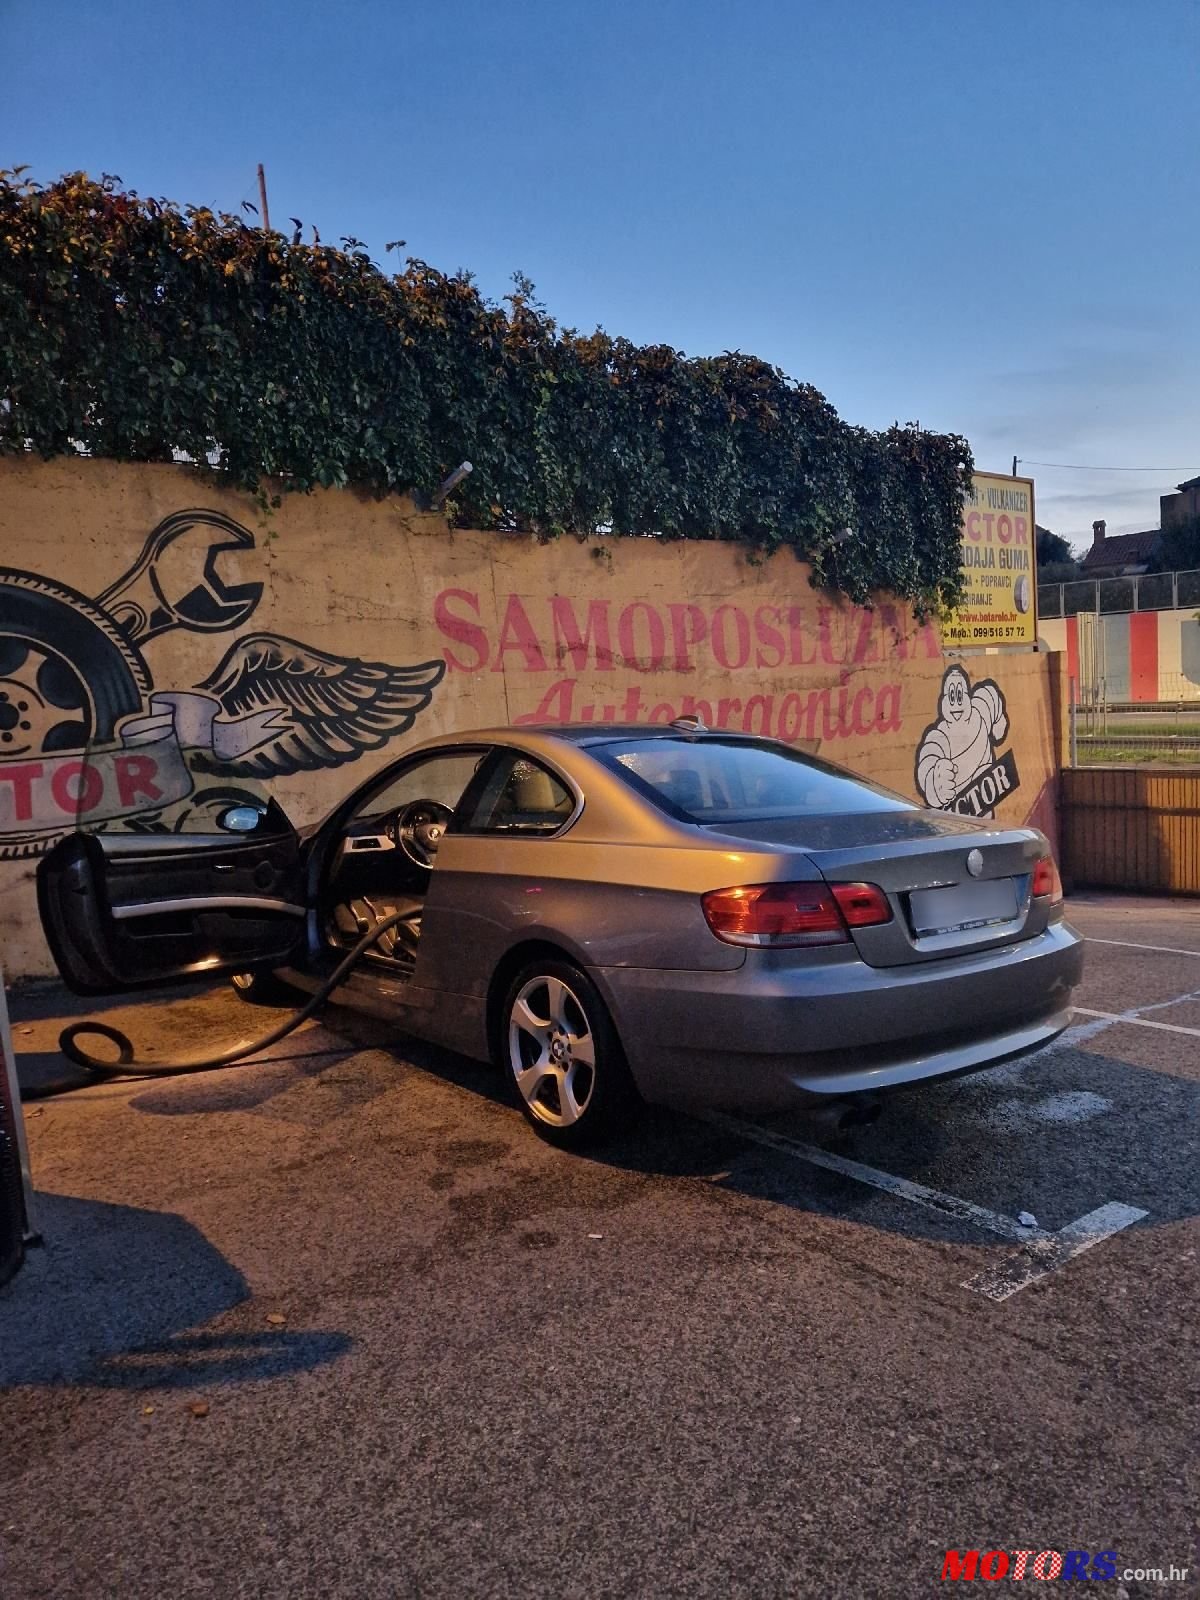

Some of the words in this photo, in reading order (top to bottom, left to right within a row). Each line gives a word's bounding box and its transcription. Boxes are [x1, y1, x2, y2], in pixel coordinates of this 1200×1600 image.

[986, 488, 1028, 512] VULKANIZER
[962, 511, 1028, 544] CTOR
[999, 547, 1029, 570] GUMA
[973, 627, 988, 637] 099
[1005, 627, 1014, 636] 57
[1016, 627, 1025, 637] 72
[946, 765, 1011, 817] CTOR
